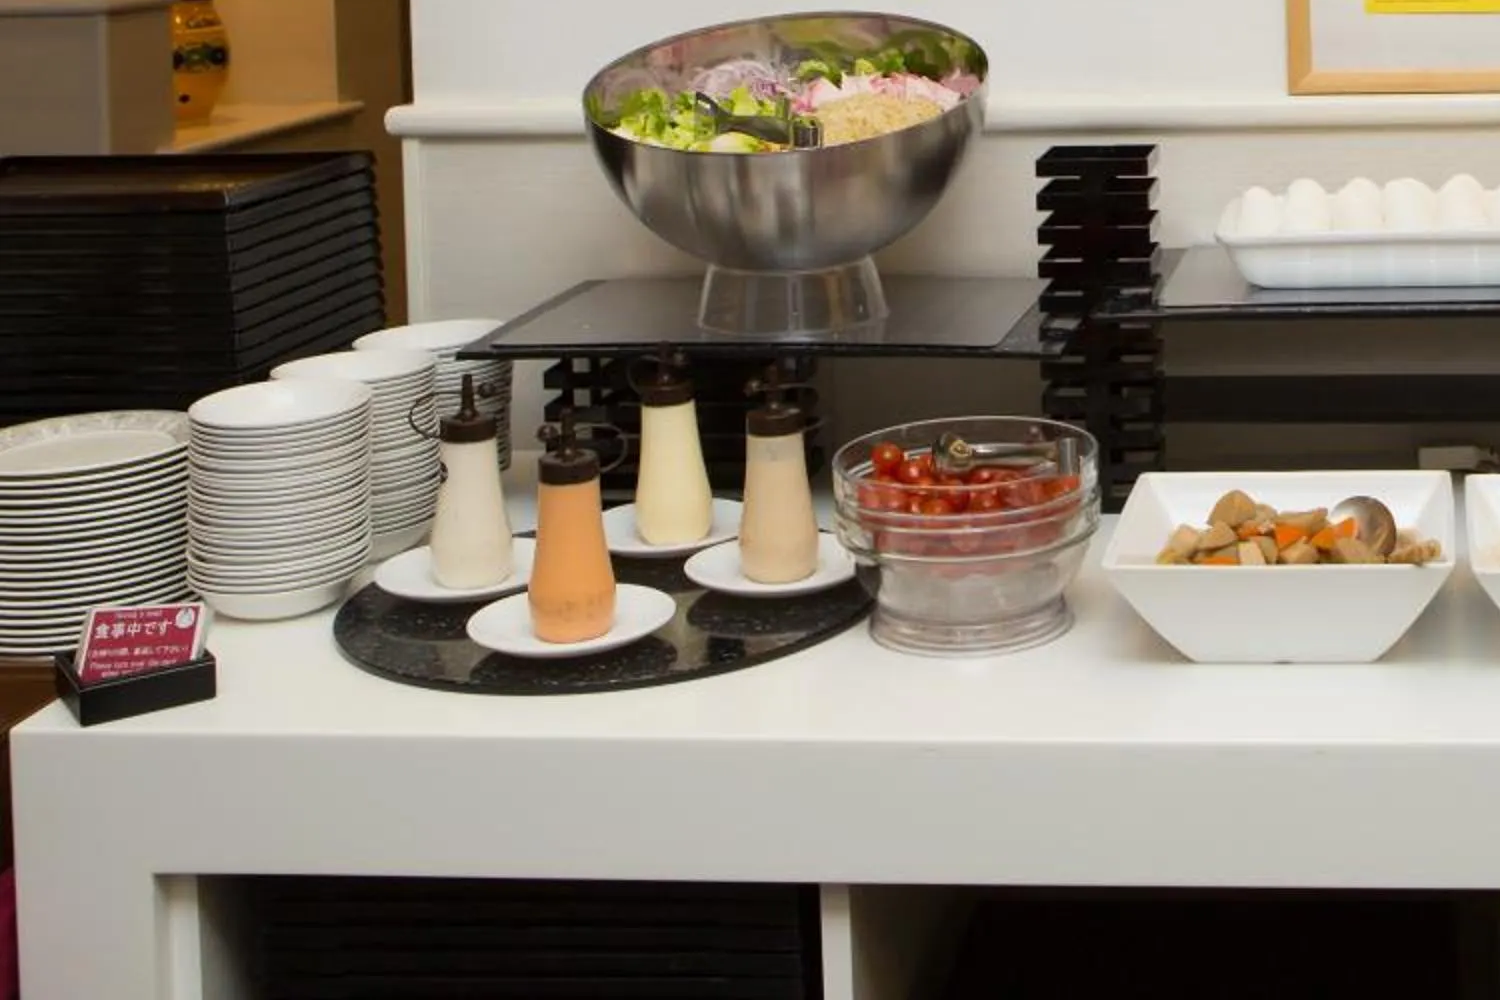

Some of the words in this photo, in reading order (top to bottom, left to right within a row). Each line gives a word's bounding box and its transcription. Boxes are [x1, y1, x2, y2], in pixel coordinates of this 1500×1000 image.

[95, 620, 173, 638] 食事中です
